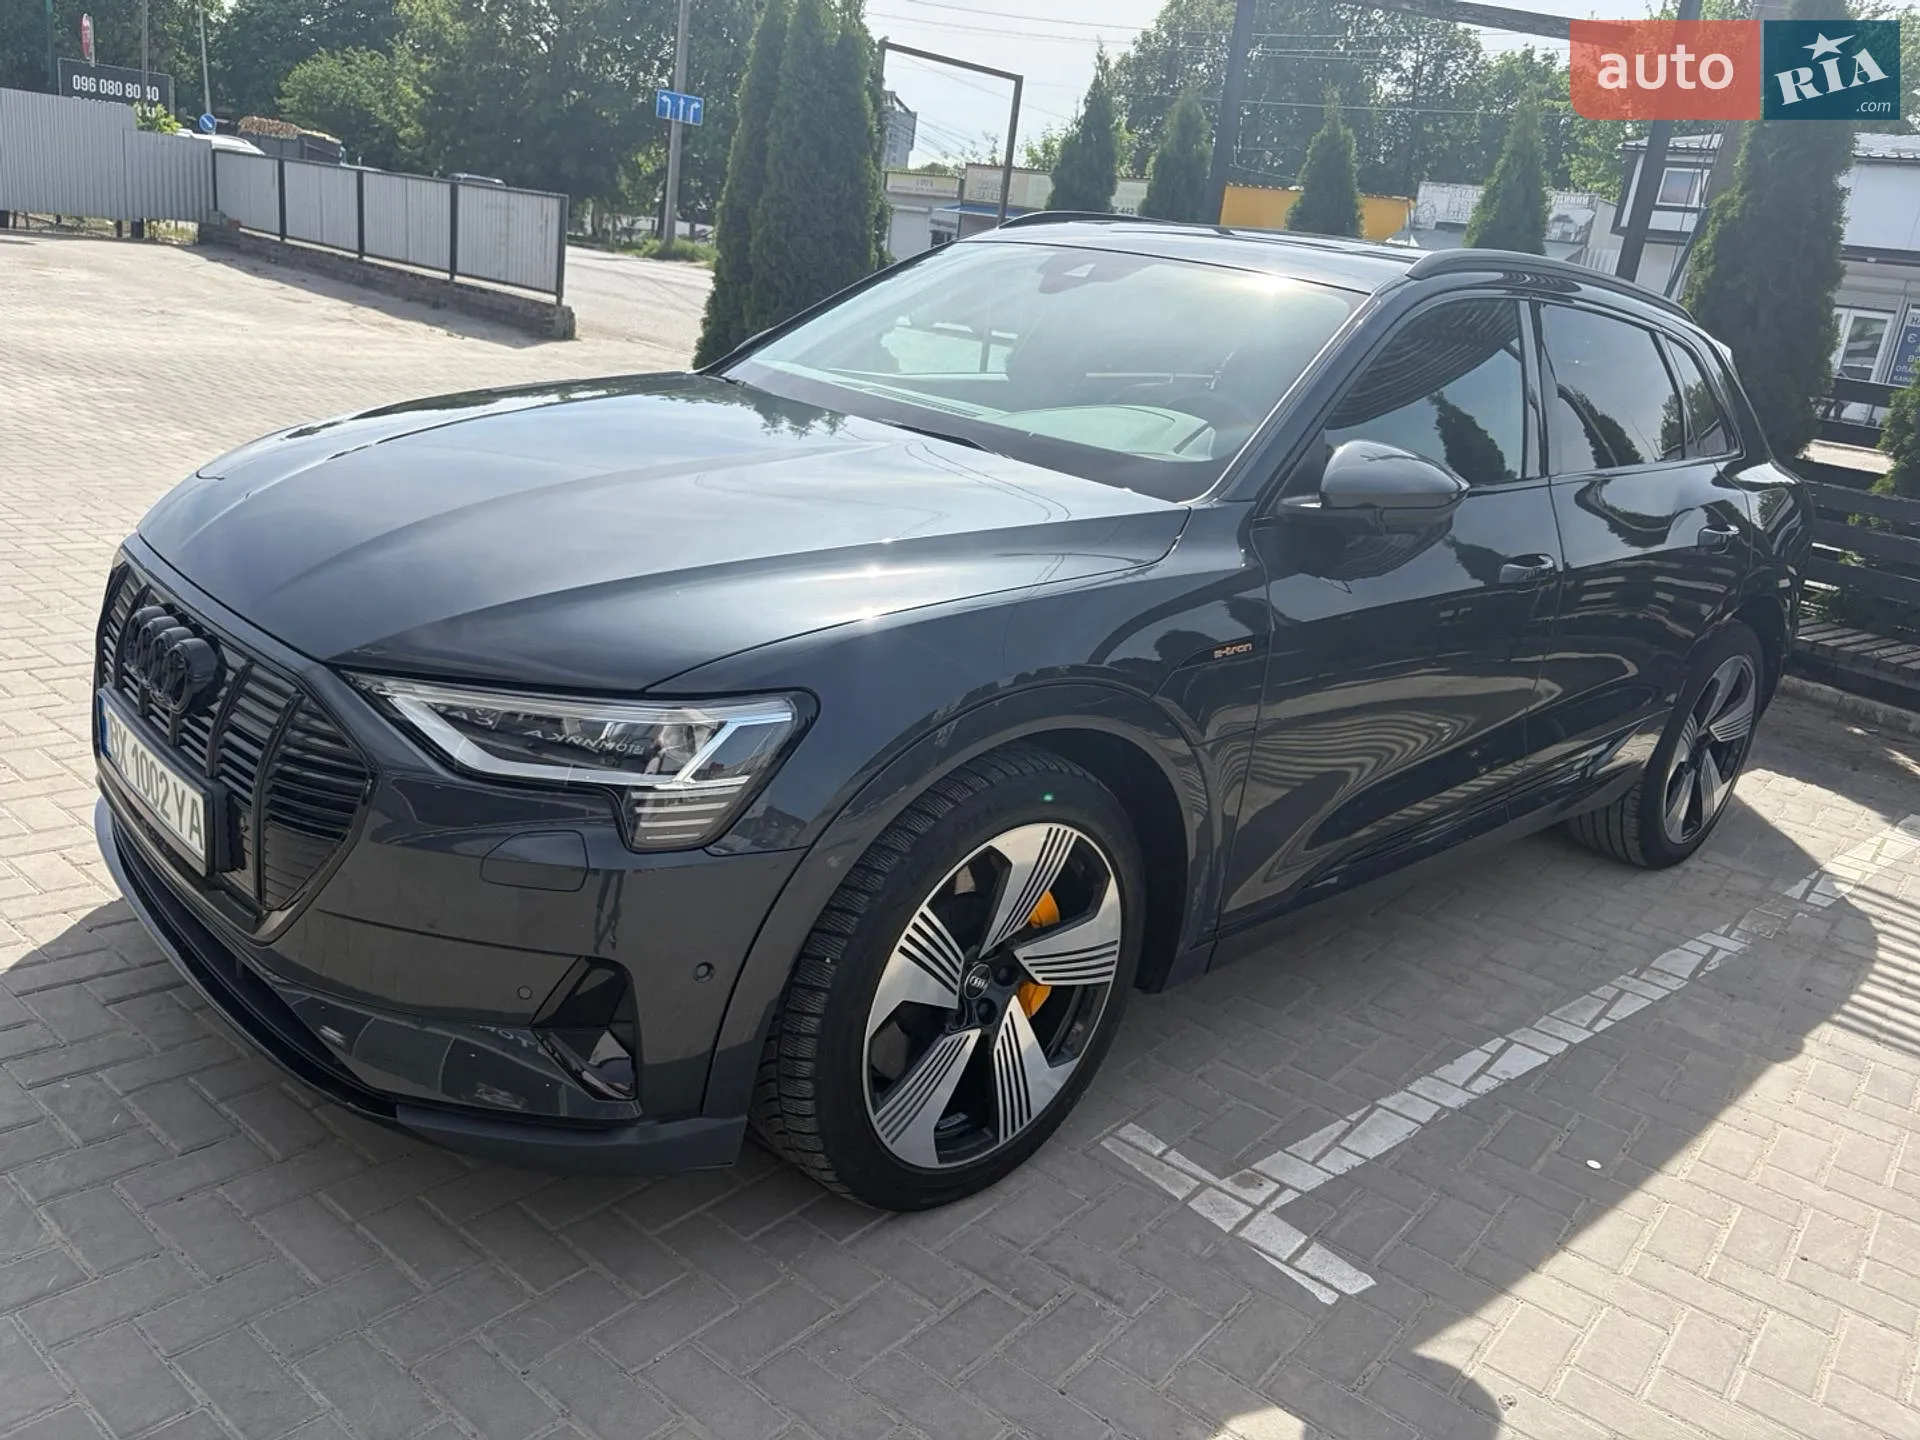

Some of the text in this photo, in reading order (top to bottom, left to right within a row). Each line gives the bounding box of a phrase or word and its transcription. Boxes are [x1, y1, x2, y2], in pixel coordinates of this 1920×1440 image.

[73, 75, 96, 92] 096
[99, 79, 122, 96] 080
[125, 83, 141, 99] 80
[1214, 643, 1252, 658] e-tron
[131, 743, 171, 820] 1002
[163, 781, 204, 850] YA
